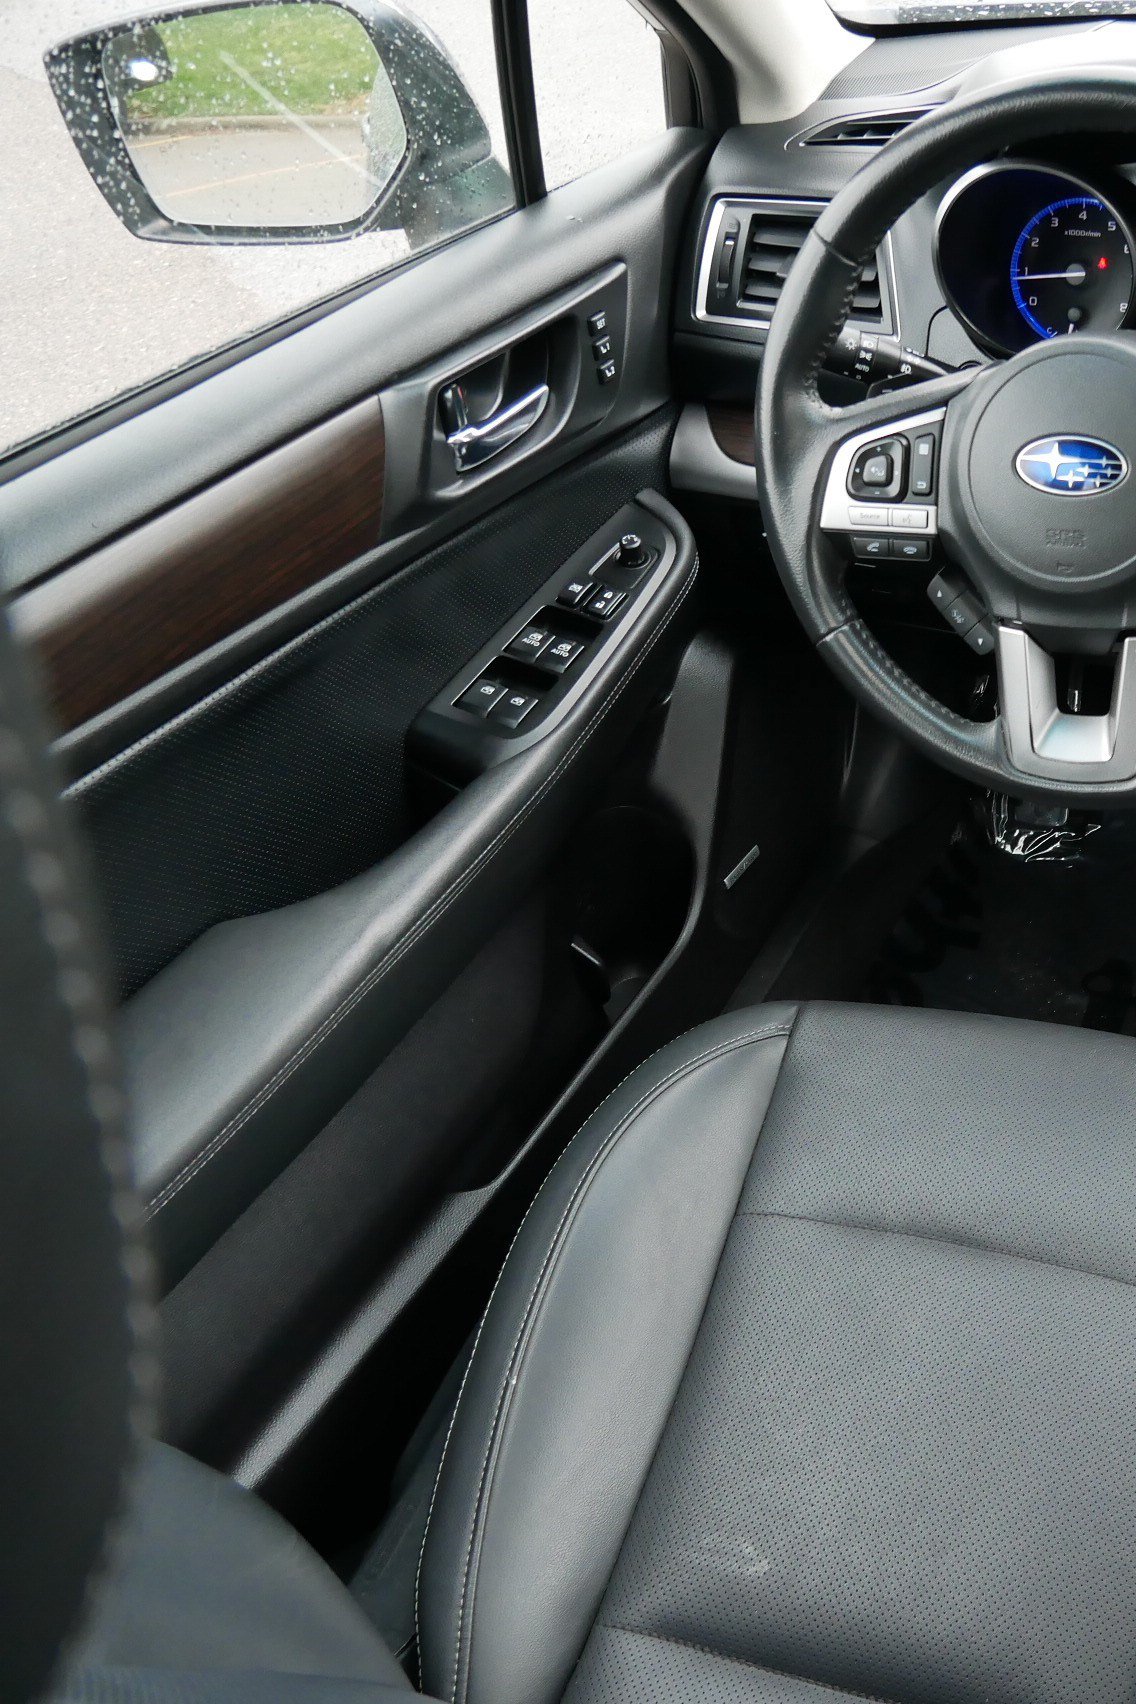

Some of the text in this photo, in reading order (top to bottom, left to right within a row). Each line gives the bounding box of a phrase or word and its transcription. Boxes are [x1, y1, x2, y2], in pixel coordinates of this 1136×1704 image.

[1079, 211, 1087, 220] 4
[1051, 217, 1059, 227] 3
[1107, 221, 1117, 231] 5
[1064, 229, 1102, 238] x1000r/min
[1031, 237, 1040, 247] 2
[1029, 296, 1038, 306] 0
[1119, 302, 1128, 313] 8
[521, 637, 541, 647] AUTO
[550, 648, 570, 658] AUTO
